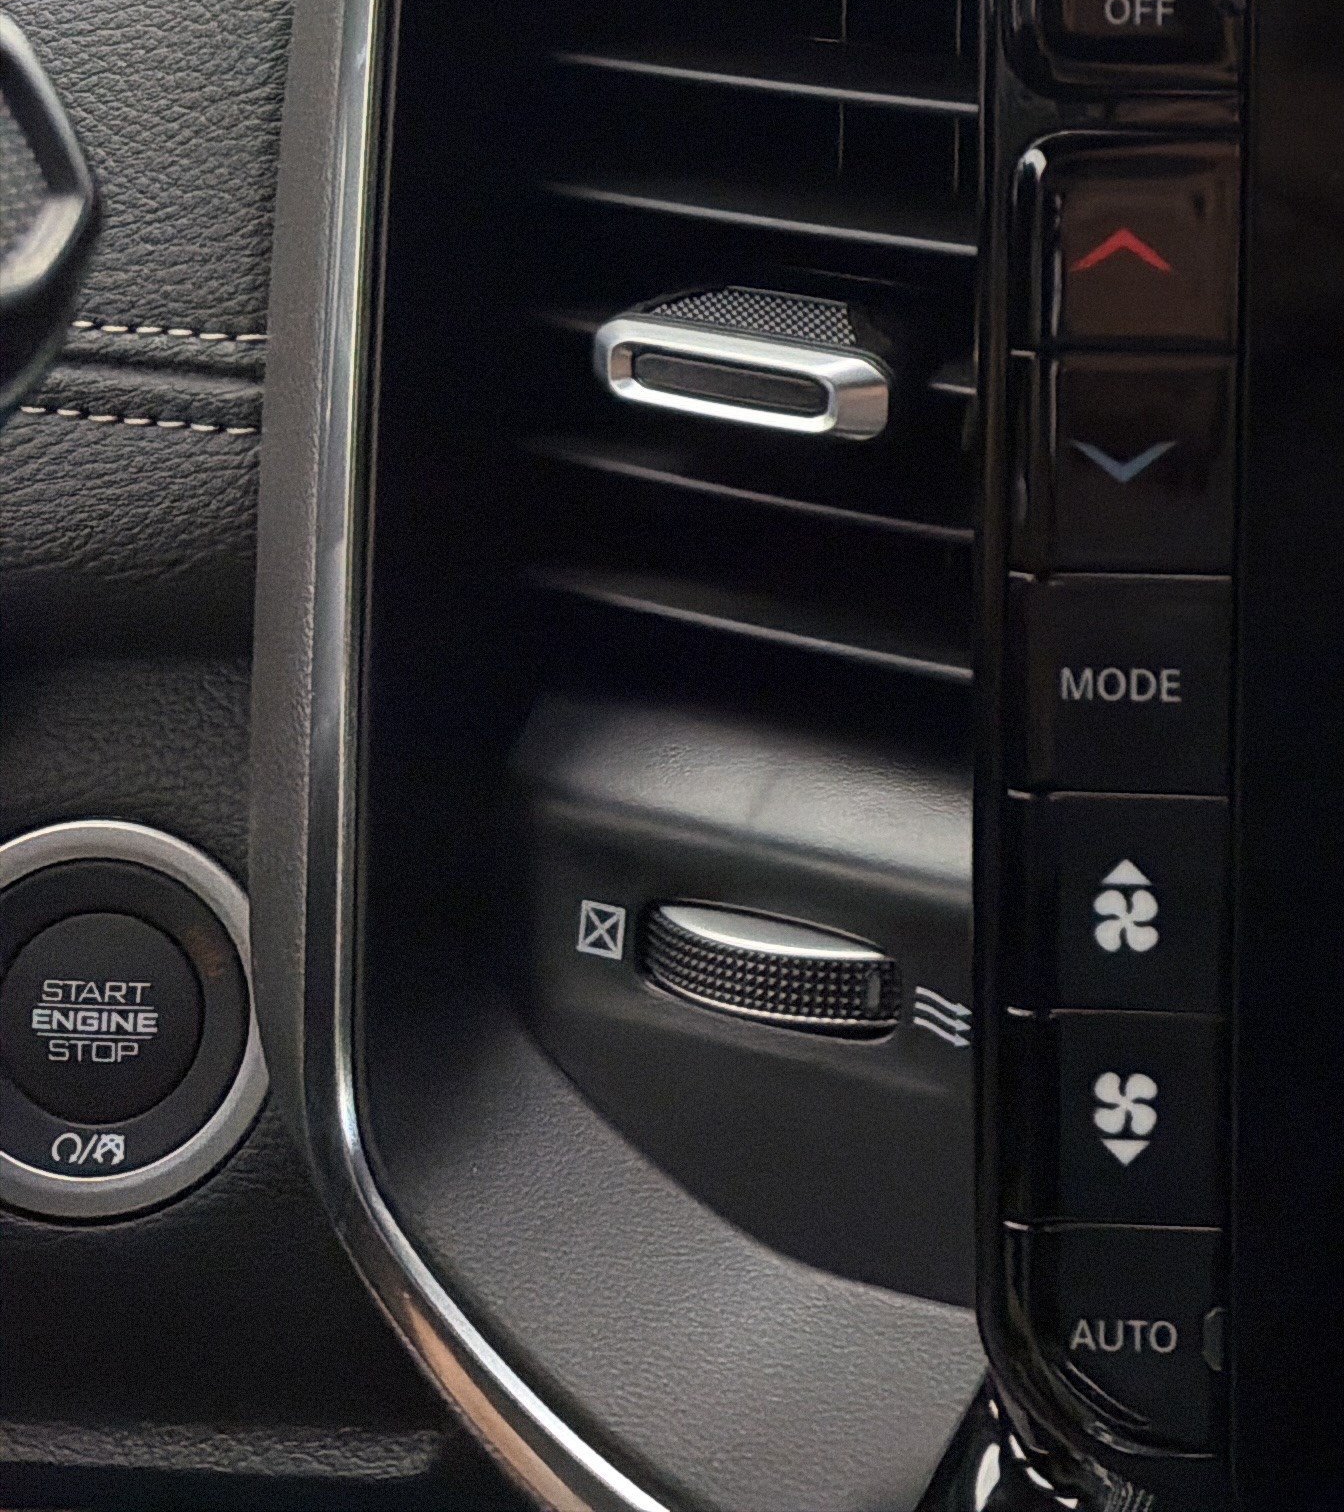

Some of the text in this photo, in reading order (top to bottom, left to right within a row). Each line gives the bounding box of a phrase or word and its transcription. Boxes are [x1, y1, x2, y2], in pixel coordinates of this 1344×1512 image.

[1060, 667, 1183, 703] MODE
[41, 980, 152, 1004] START
[31, 1009, 159, 1034] ENGINE
[48, 1040, 139, 1063] STOP
[1069, 1319, 1178, 1353] AUTO
